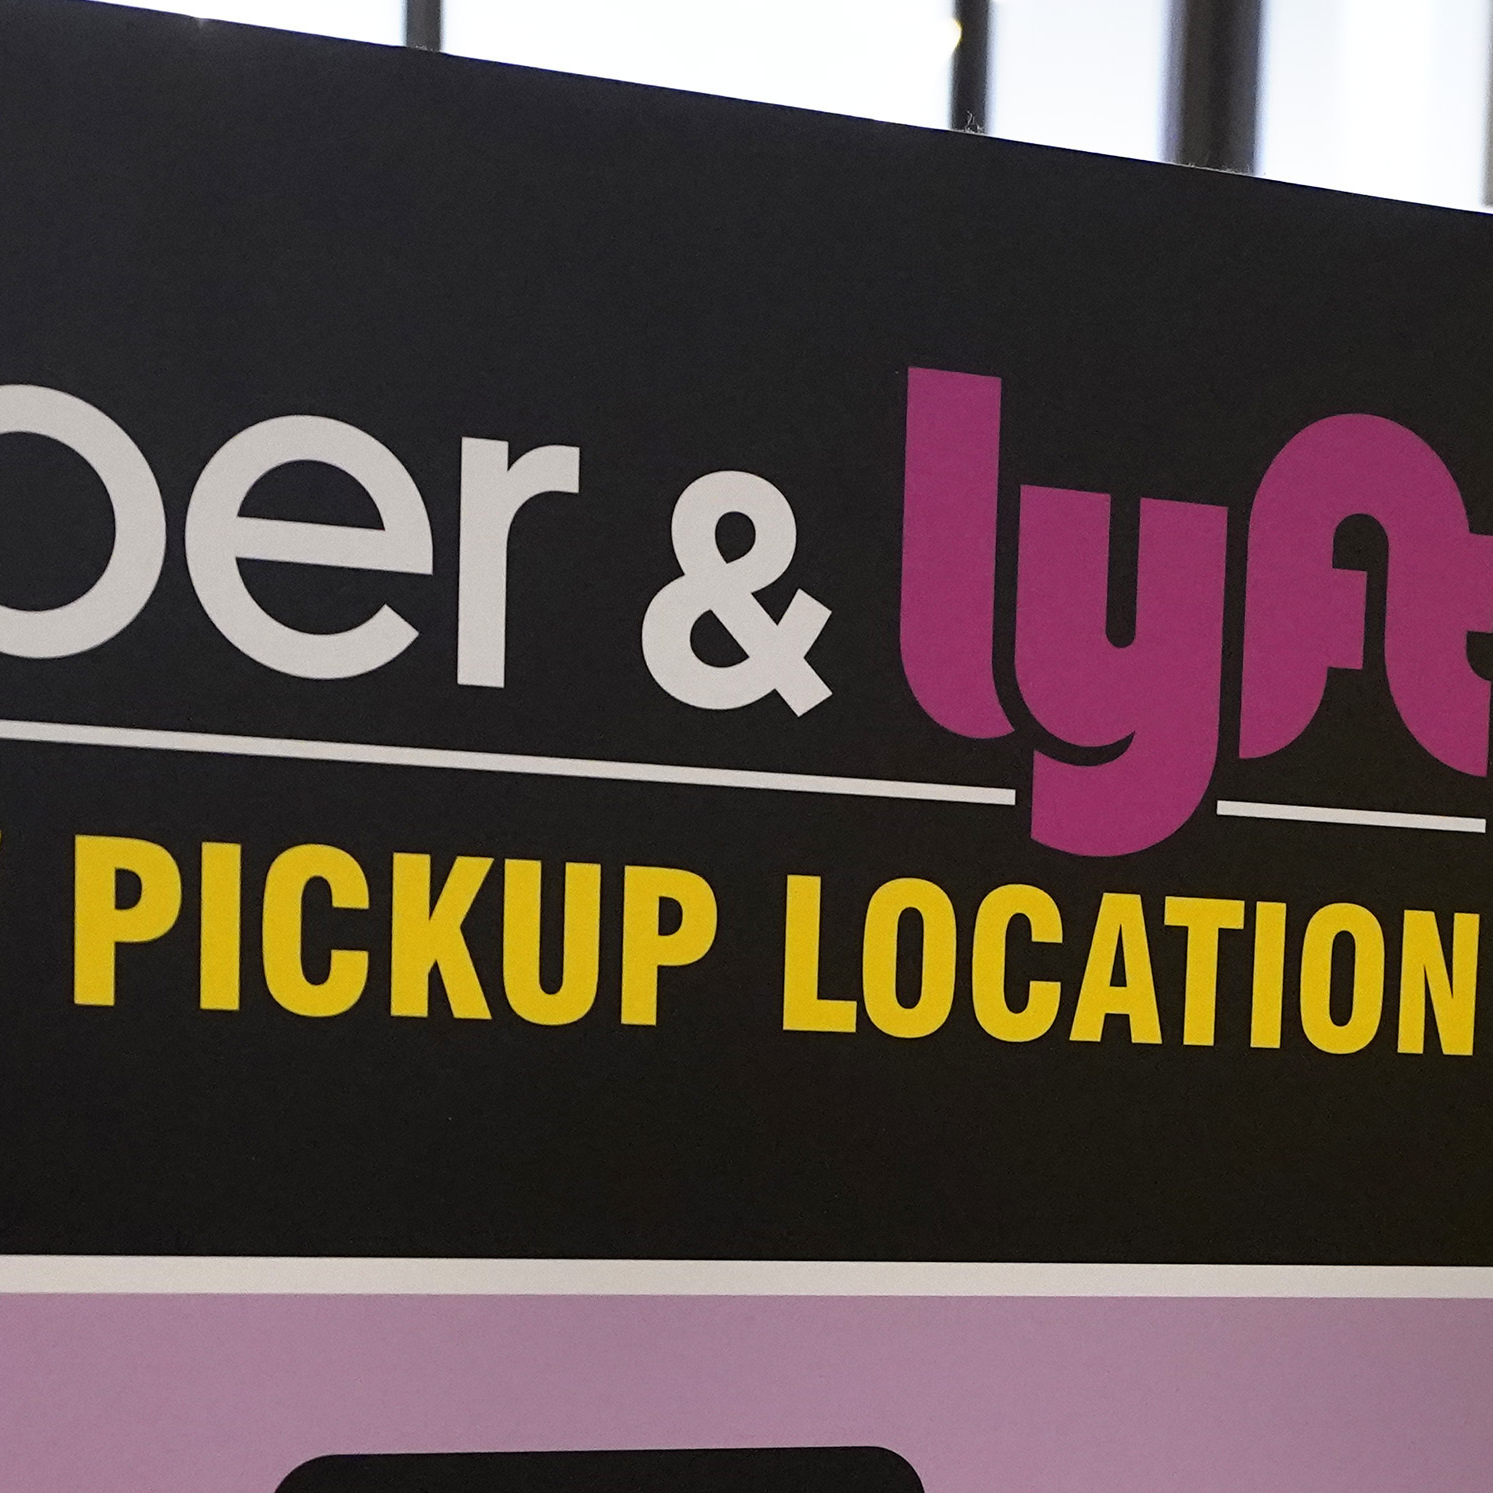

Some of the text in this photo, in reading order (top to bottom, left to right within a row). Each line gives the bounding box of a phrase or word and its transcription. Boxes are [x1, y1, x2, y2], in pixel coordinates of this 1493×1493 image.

[642, 471, 832, 717] &
[74, 835, 717, 1027] PICKUP
[783, 875, 1480, 1057] LOCATION
